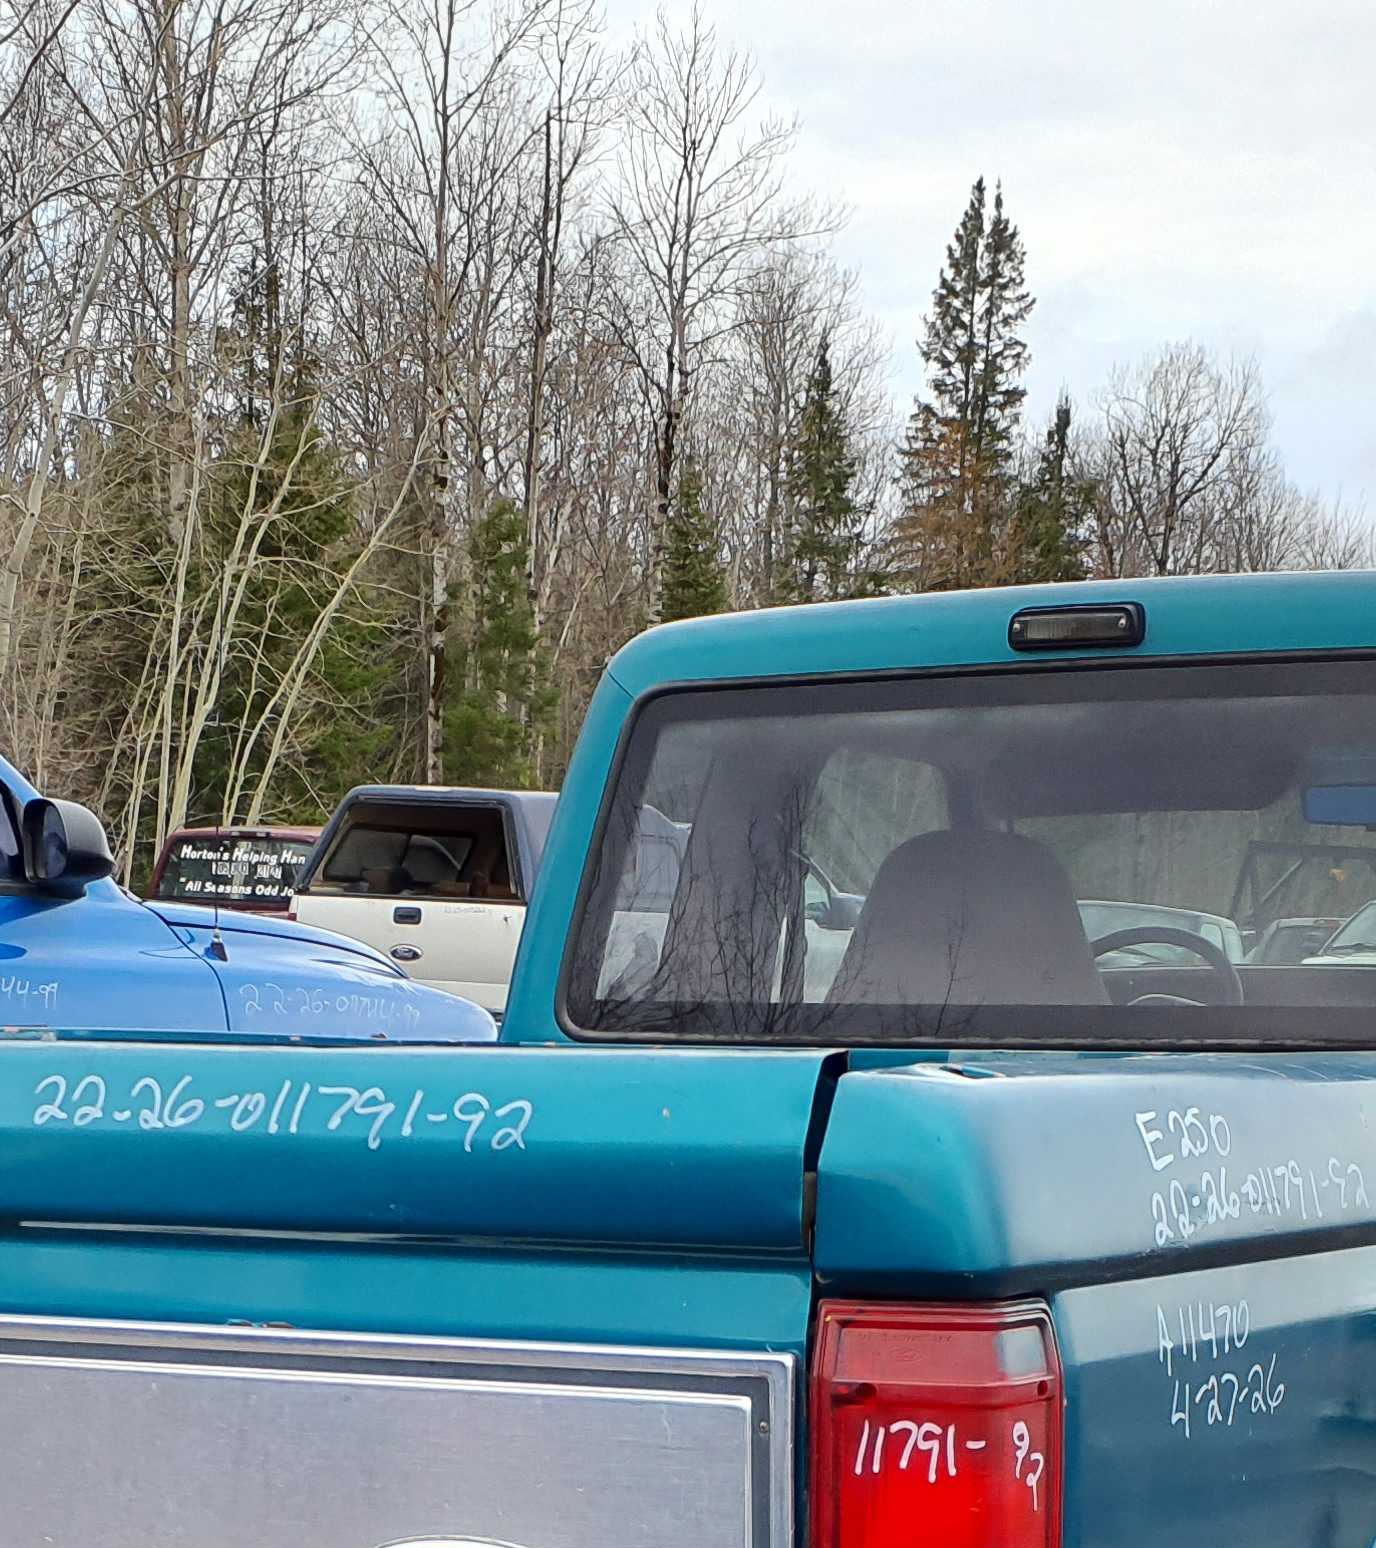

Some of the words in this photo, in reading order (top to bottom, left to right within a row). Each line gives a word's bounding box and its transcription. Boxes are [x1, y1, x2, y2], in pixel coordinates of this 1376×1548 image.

[232, 847, 278, 865] Helping
[255, 884, 279, 896] Odd
[32, 1073, 534, 1153] 22-26-011791-92
[1156, 1299, 1250, 1377] A11470
